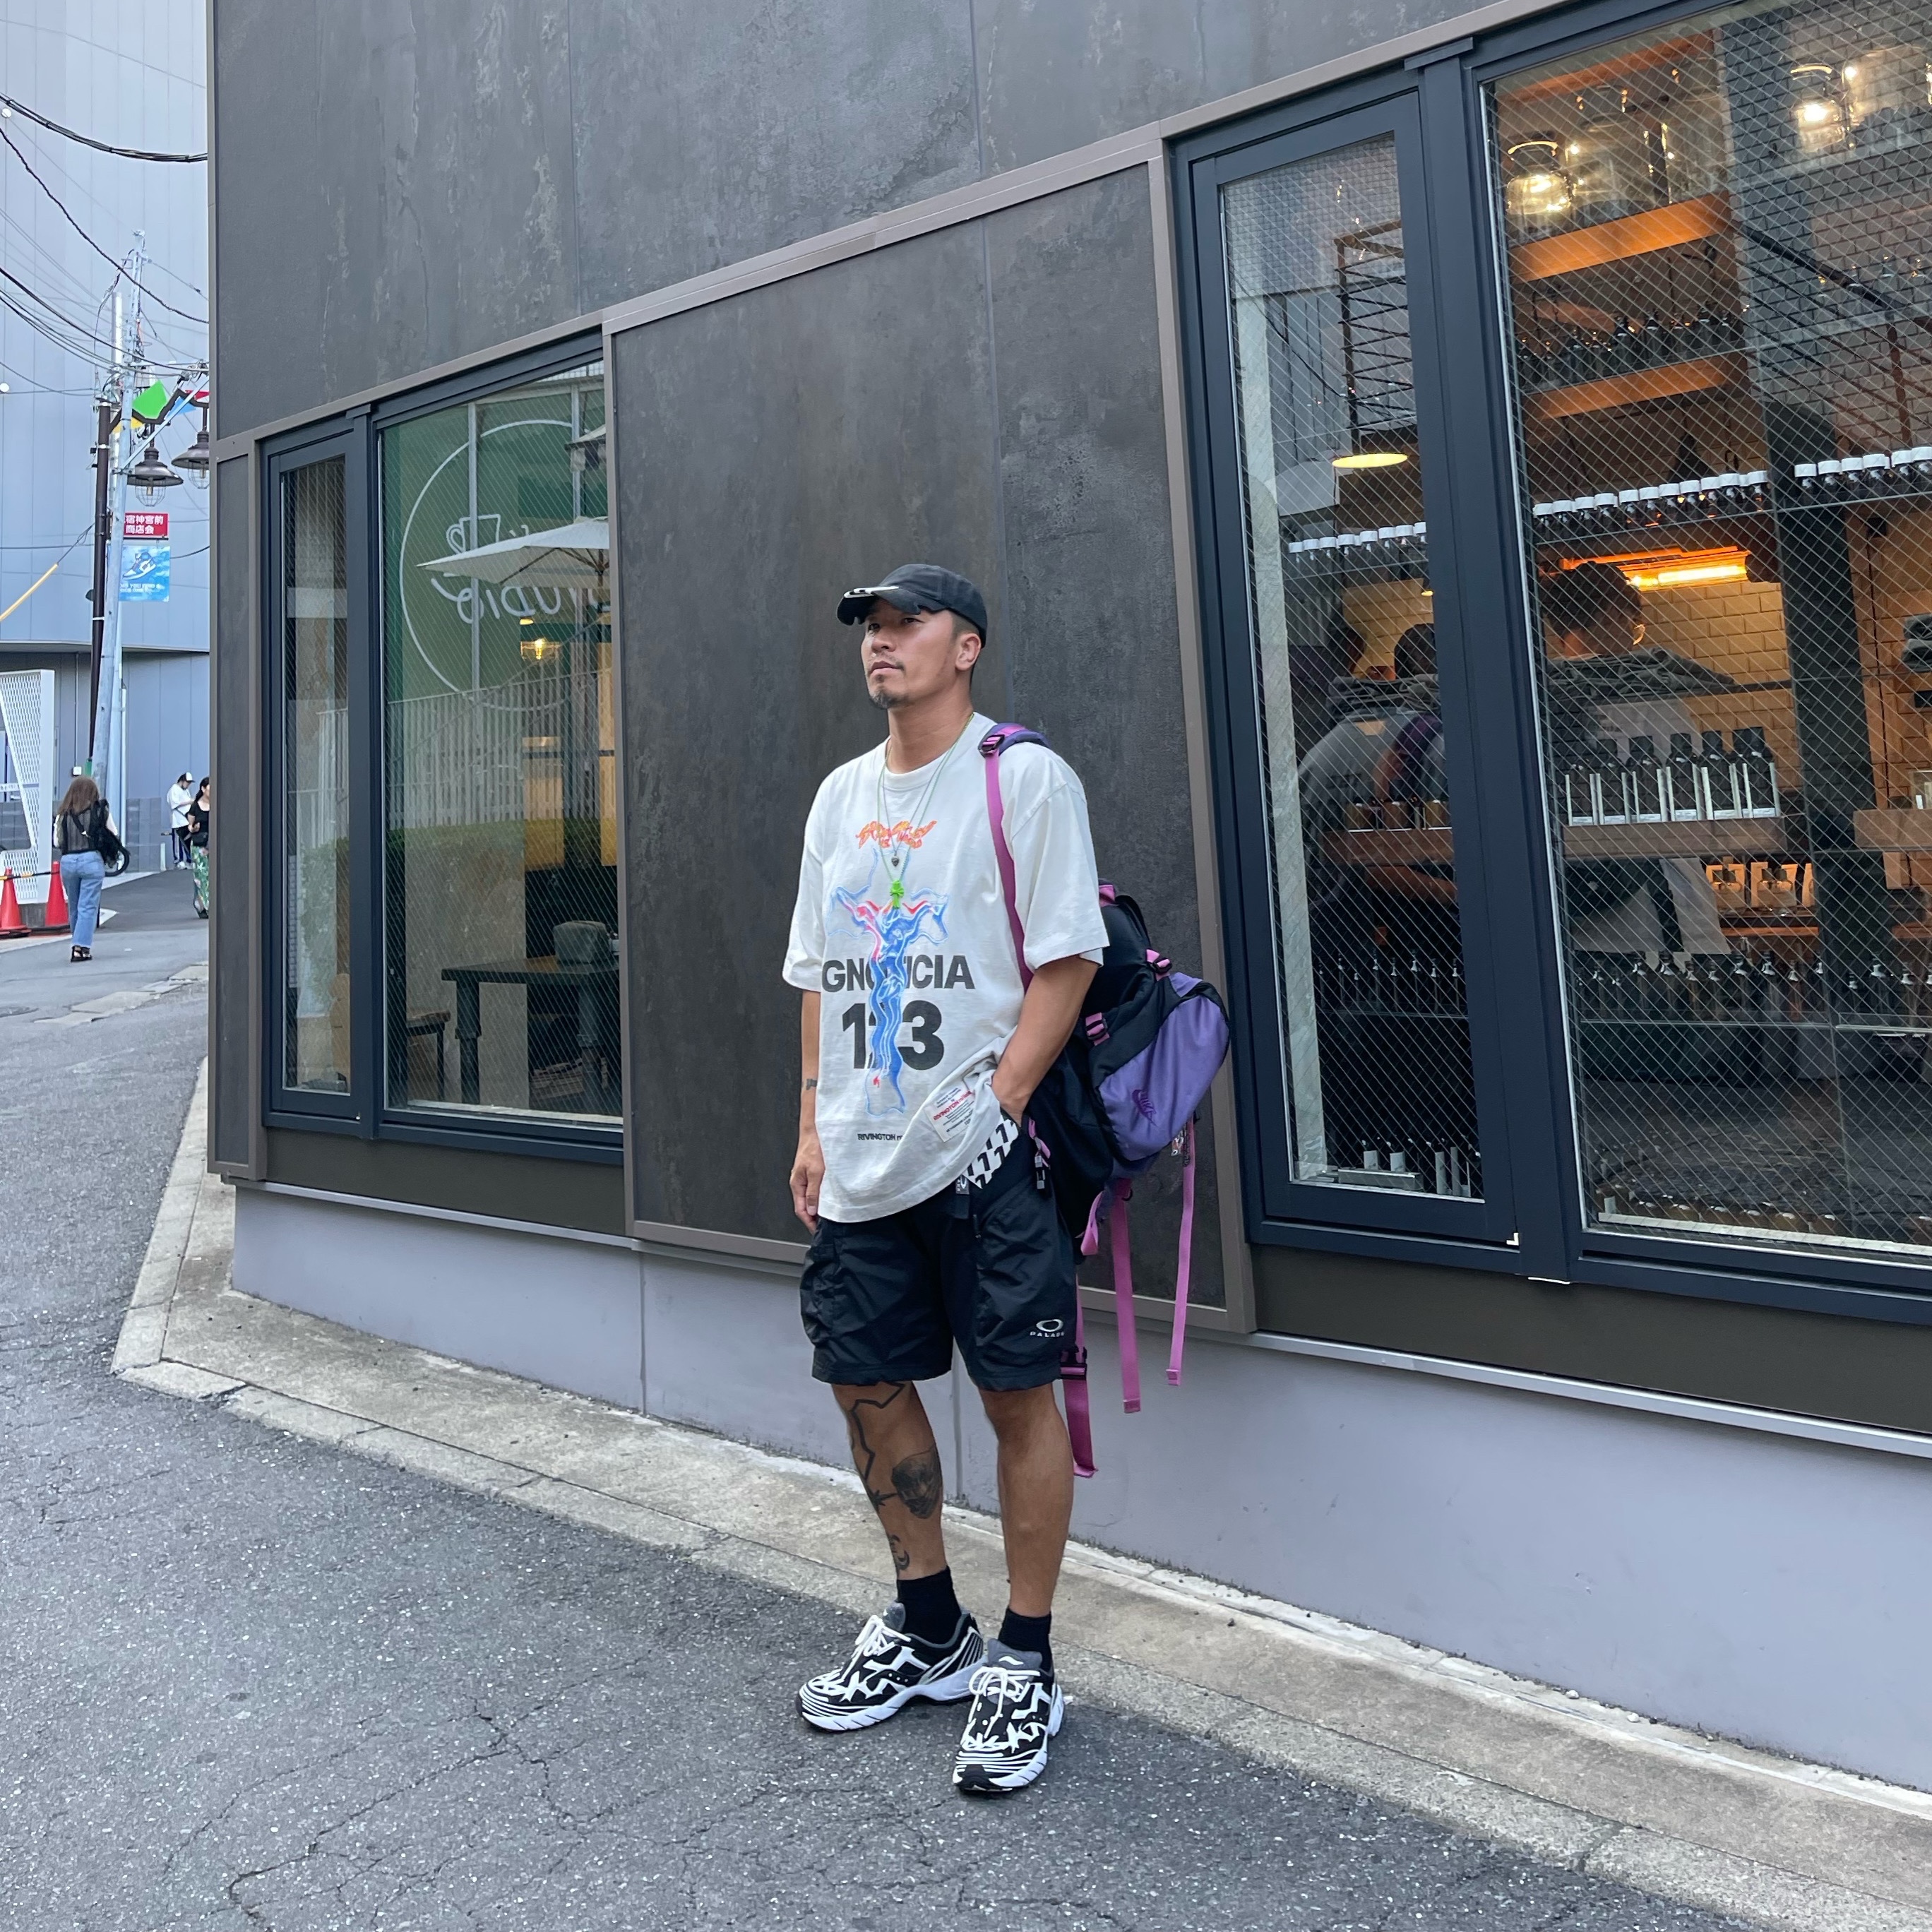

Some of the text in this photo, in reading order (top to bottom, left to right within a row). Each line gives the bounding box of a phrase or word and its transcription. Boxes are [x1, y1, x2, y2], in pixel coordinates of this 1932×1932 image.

[124, 515, 163, 525] 宿神宮前
[842, 1000, 944, 1071] 13
